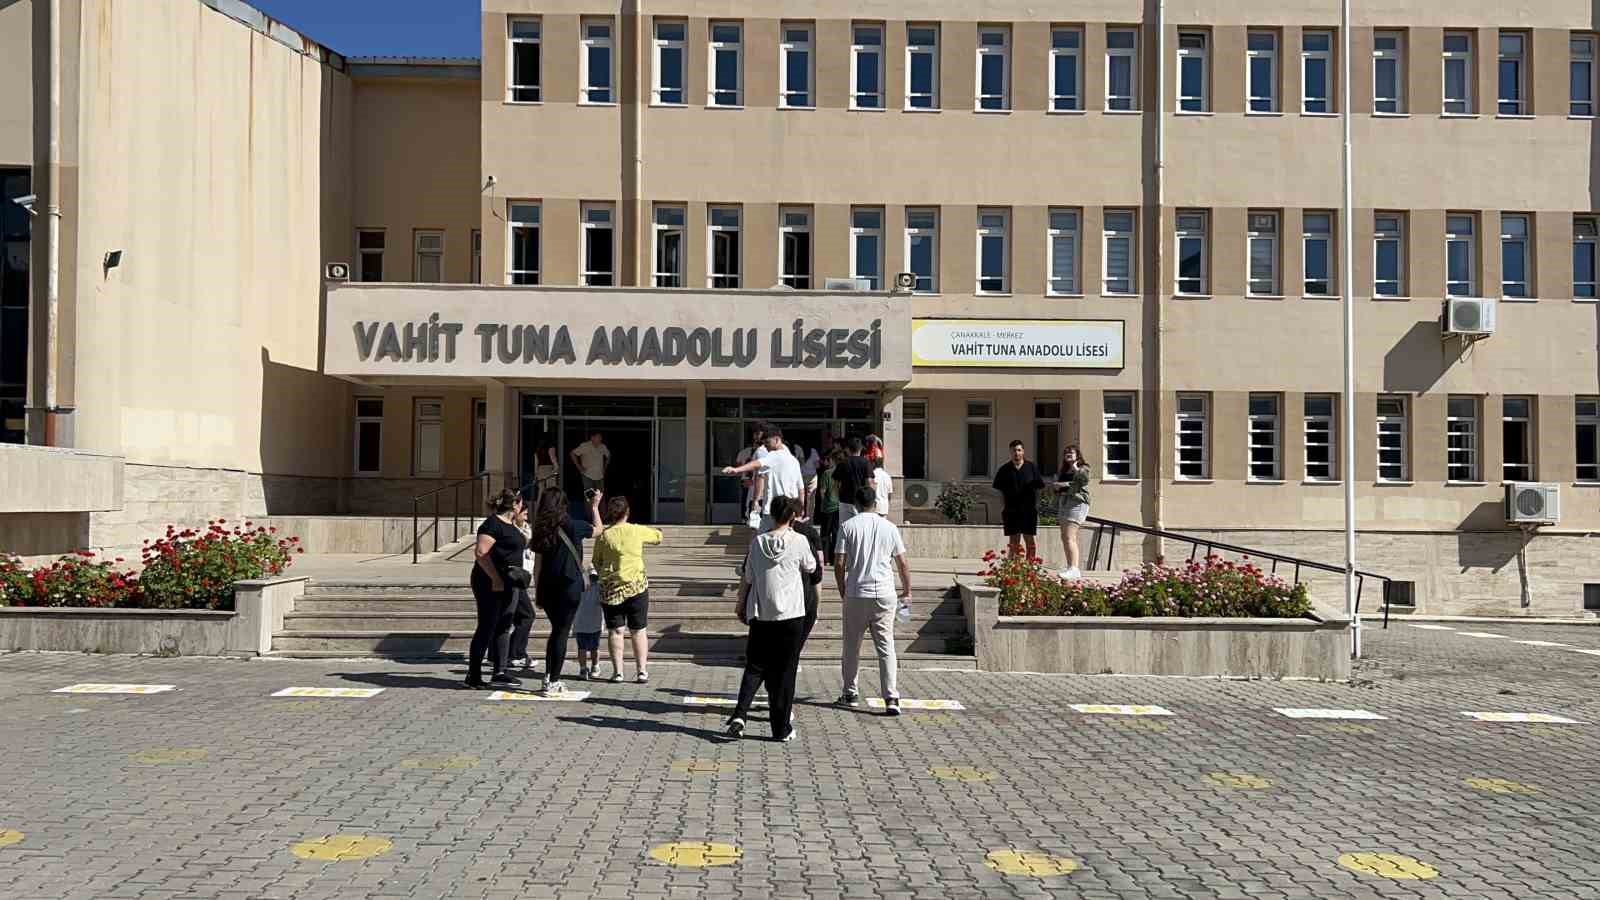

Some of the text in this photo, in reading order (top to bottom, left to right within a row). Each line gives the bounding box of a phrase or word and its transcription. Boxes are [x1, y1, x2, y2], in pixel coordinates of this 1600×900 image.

[353, 312, 883, 370] VAHİT TUNA ANADOLU LİSESİ
[996, 331, 1024, 339] MERKEZ
[952, 342, 1108, 357] VAHİT TUNA ANADOLU LİSESİ
